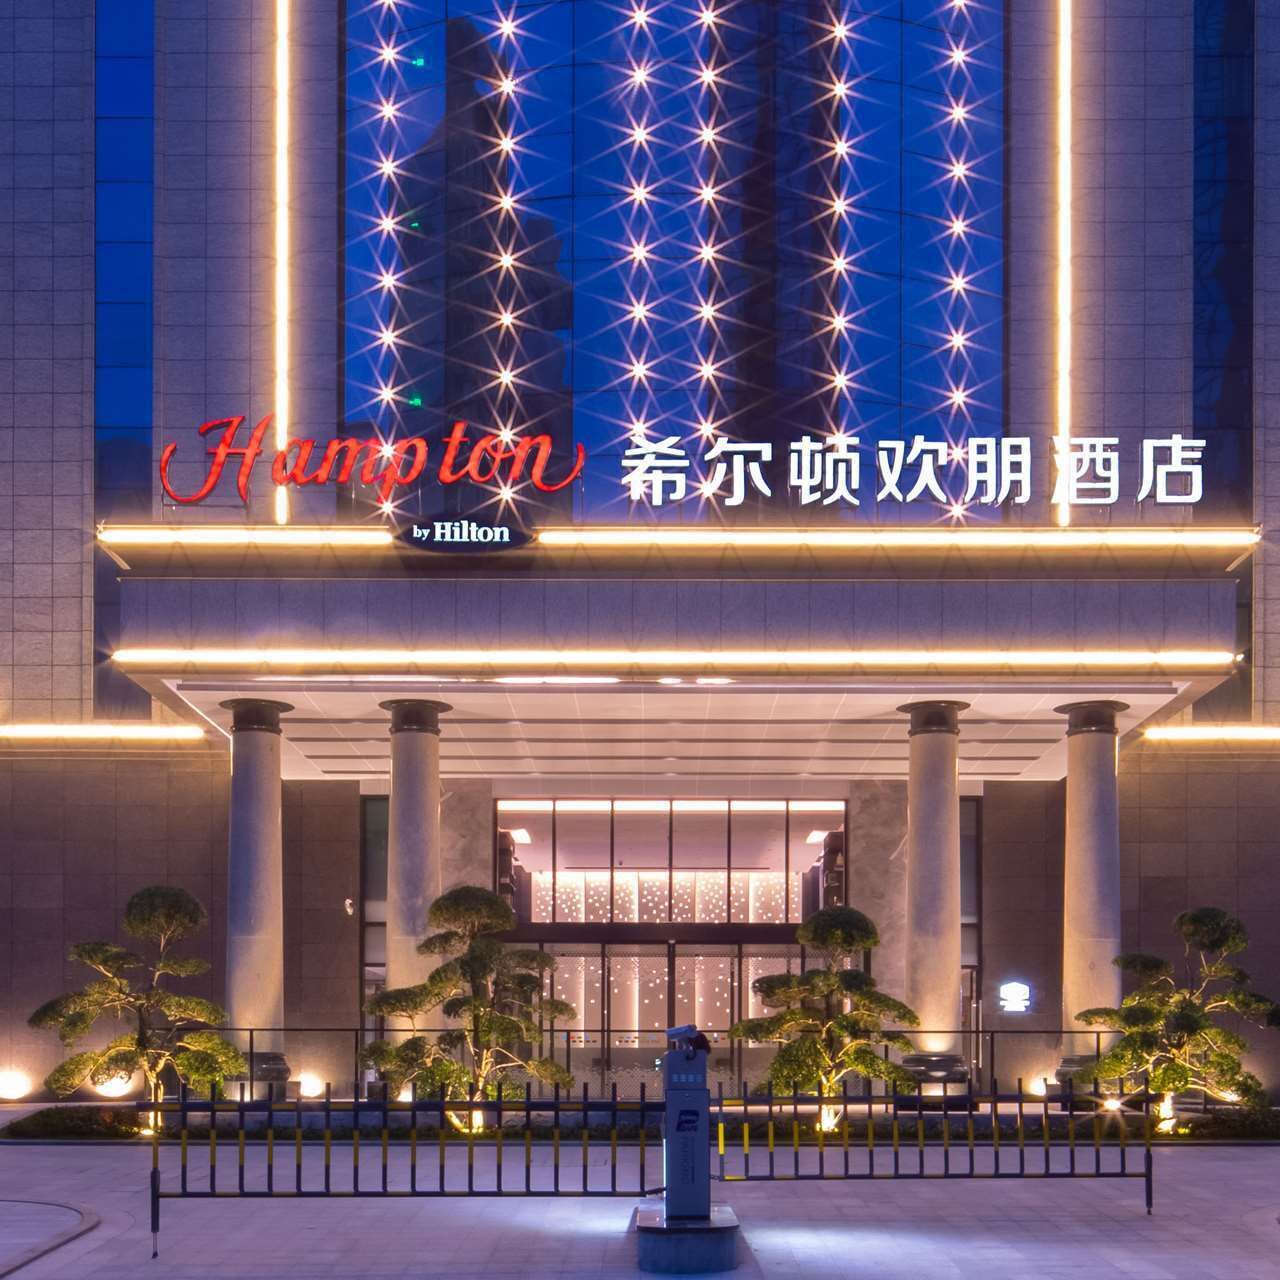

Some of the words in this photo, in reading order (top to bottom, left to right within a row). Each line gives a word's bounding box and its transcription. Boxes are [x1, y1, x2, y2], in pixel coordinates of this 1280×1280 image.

[160, 413, 586, 504] Hampton
[621, 433, 1207, 506] 希尔顿欢朋酒店
[412, 524, 430, 540] by
[433, 520, 510, 543] Hilton
